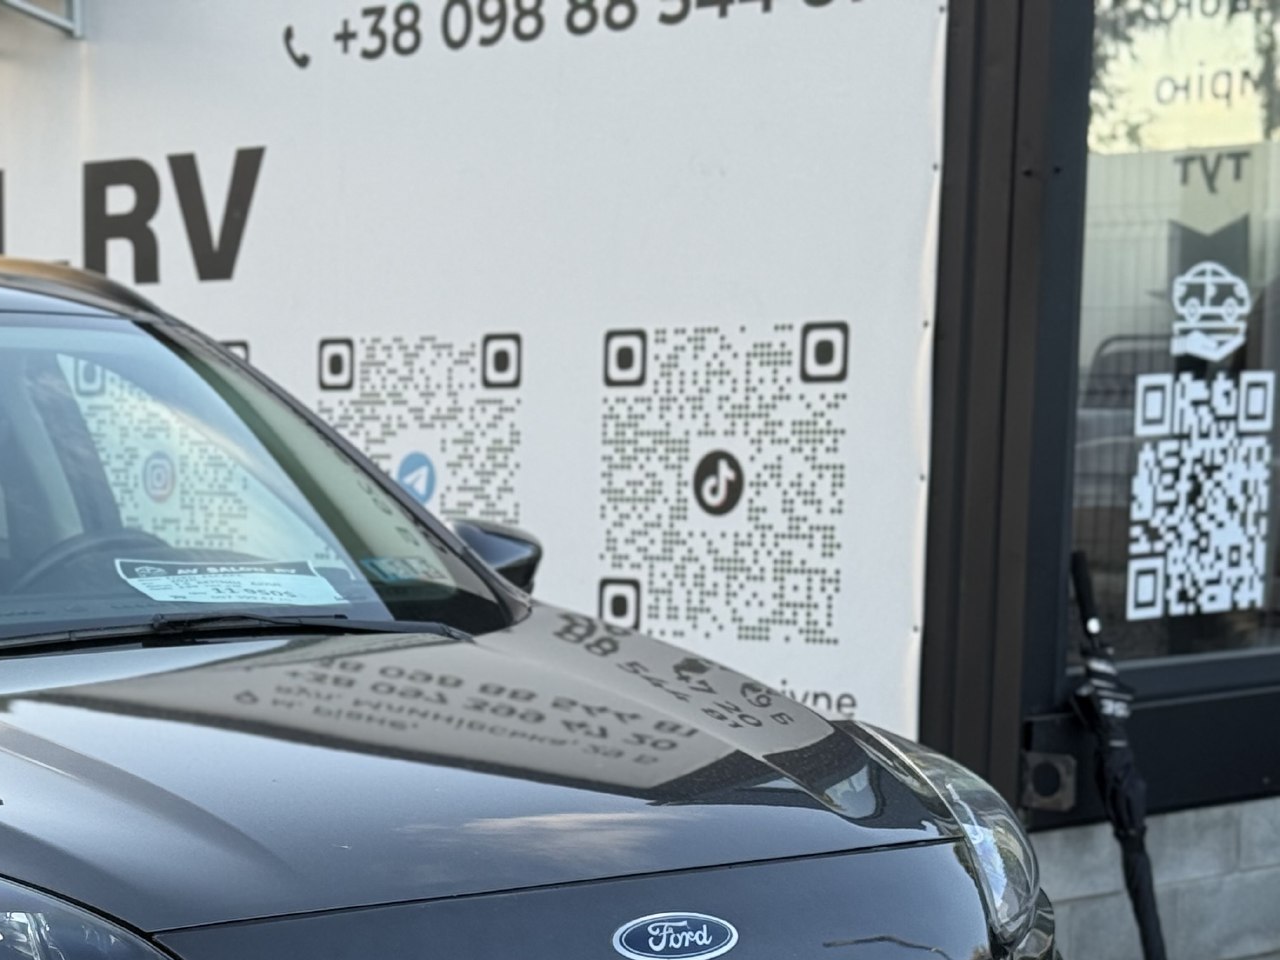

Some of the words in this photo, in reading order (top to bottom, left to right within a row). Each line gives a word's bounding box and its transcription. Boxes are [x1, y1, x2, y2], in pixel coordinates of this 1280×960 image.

[333, 1, 423, 60] +38
[440, 0, 545, 51] 098
[82, 146, 267, 284] RV
[647, 920, 713, 952] Ford
